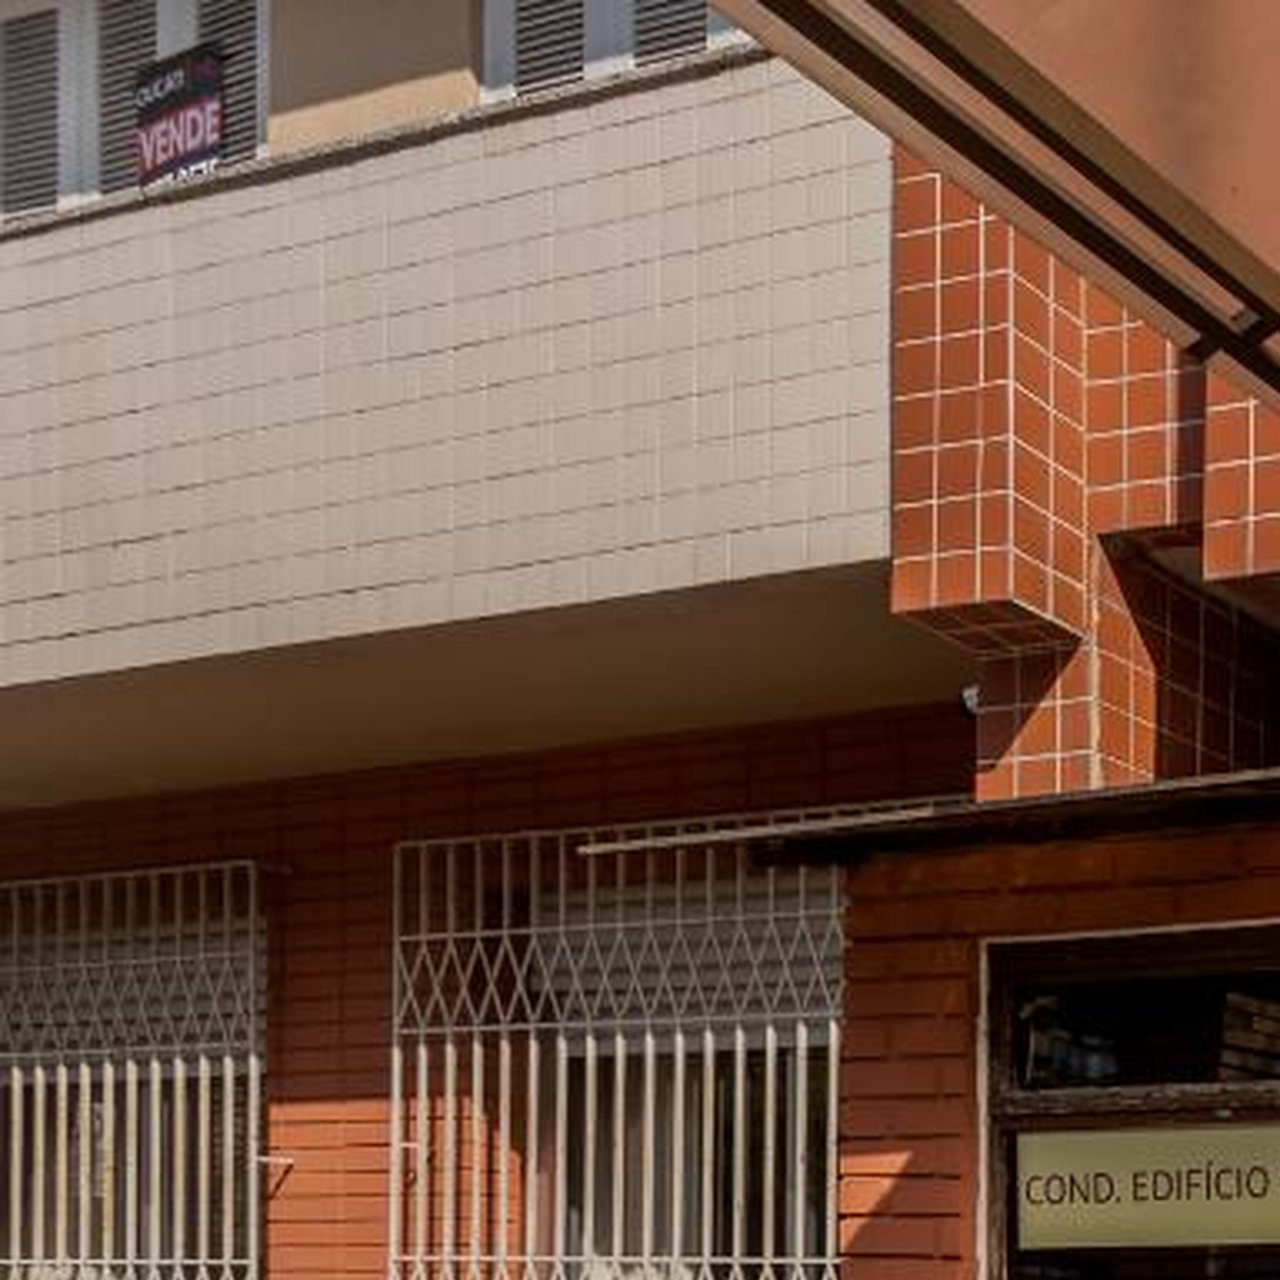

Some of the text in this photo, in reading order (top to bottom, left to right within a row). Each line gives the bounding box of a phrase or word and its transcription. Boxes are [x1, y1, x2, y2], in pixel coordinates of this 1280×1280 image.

[138, 98, 221, 171] VENDE
[1024, 1172, 1121, 1205] COND.
[1133, 1160, 1271, 1201] EDIFÍCIO
